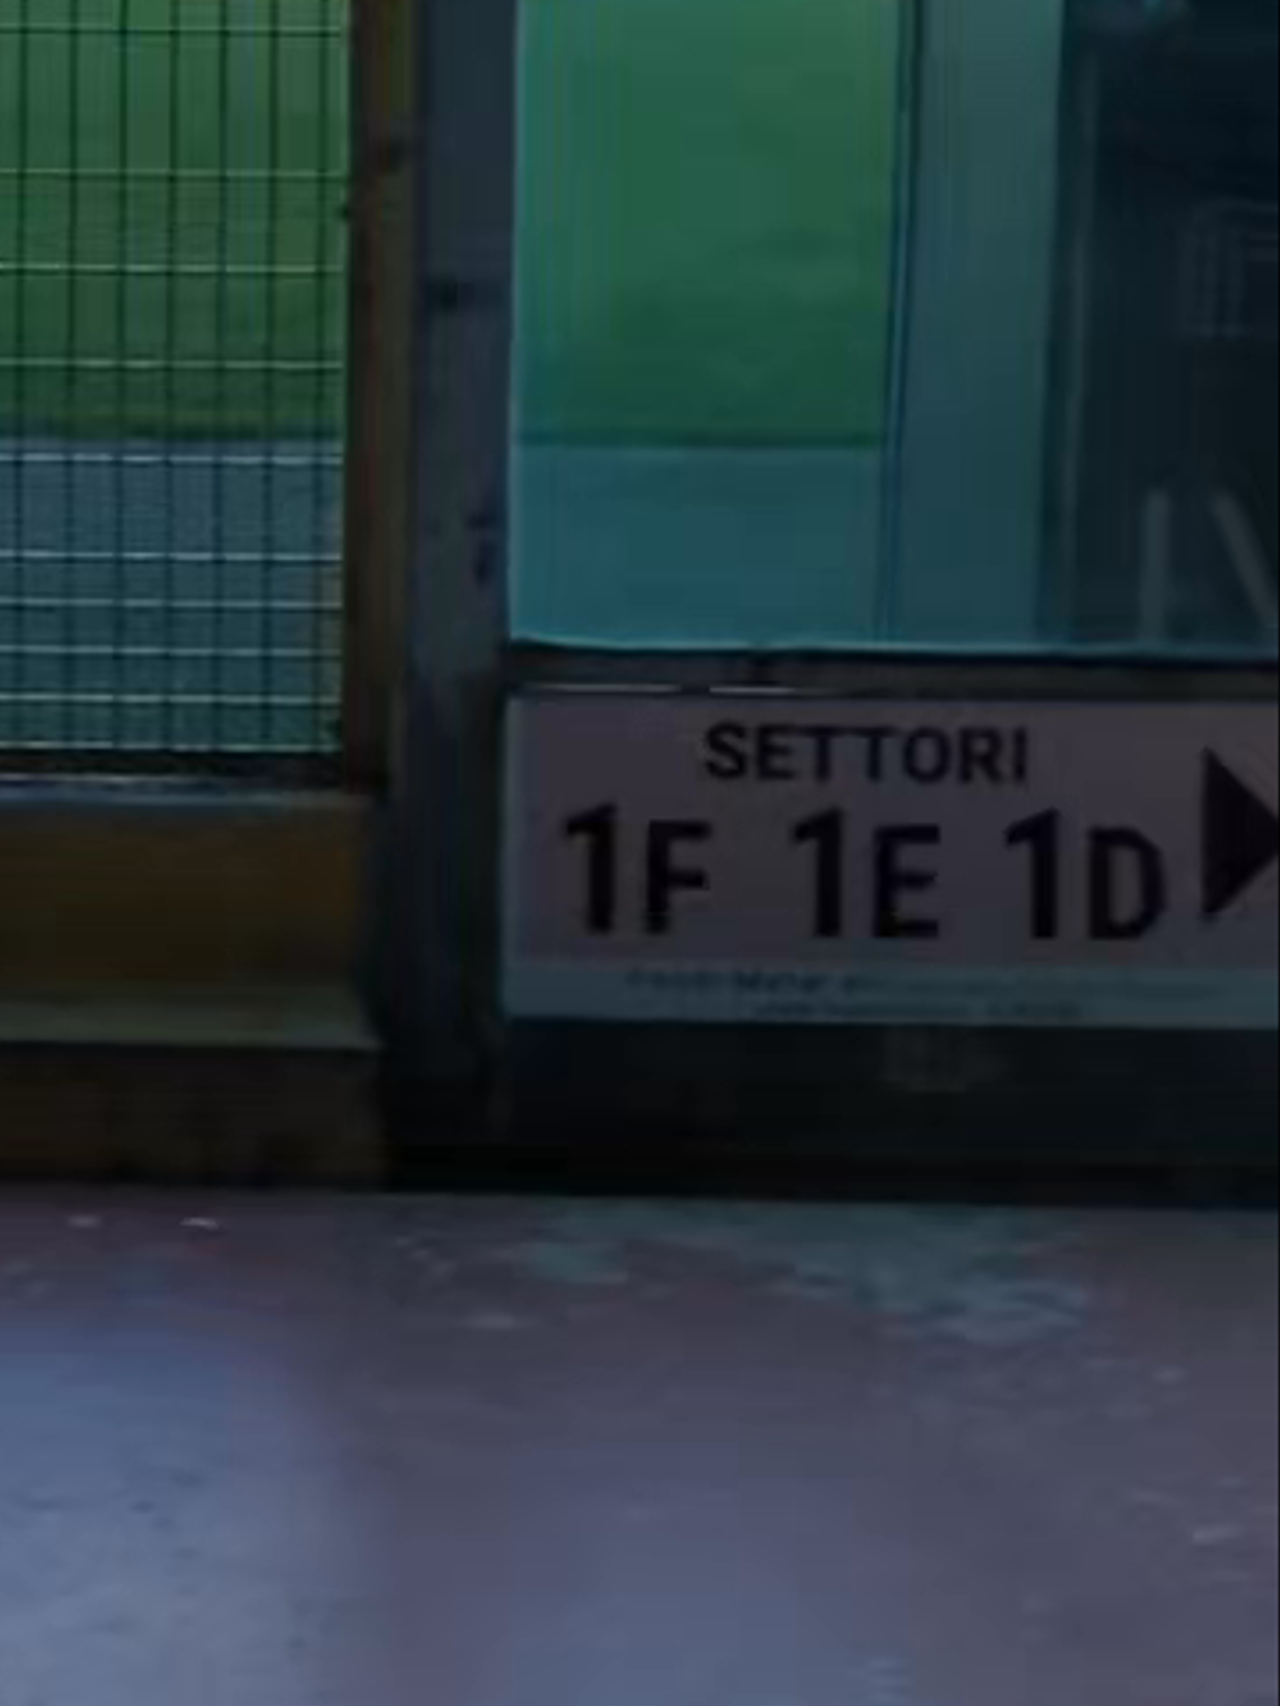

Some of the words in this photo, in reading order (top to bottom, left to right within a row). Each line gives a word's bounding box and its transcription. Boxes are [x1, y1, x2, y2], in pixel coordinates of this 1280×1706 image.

[703, 722, 1026, 784] SETTORI
[564, 803, 712, 935] 1F
[794, 806, 939, 937] 1E
[1004, 806, 1167, 939] 1D
